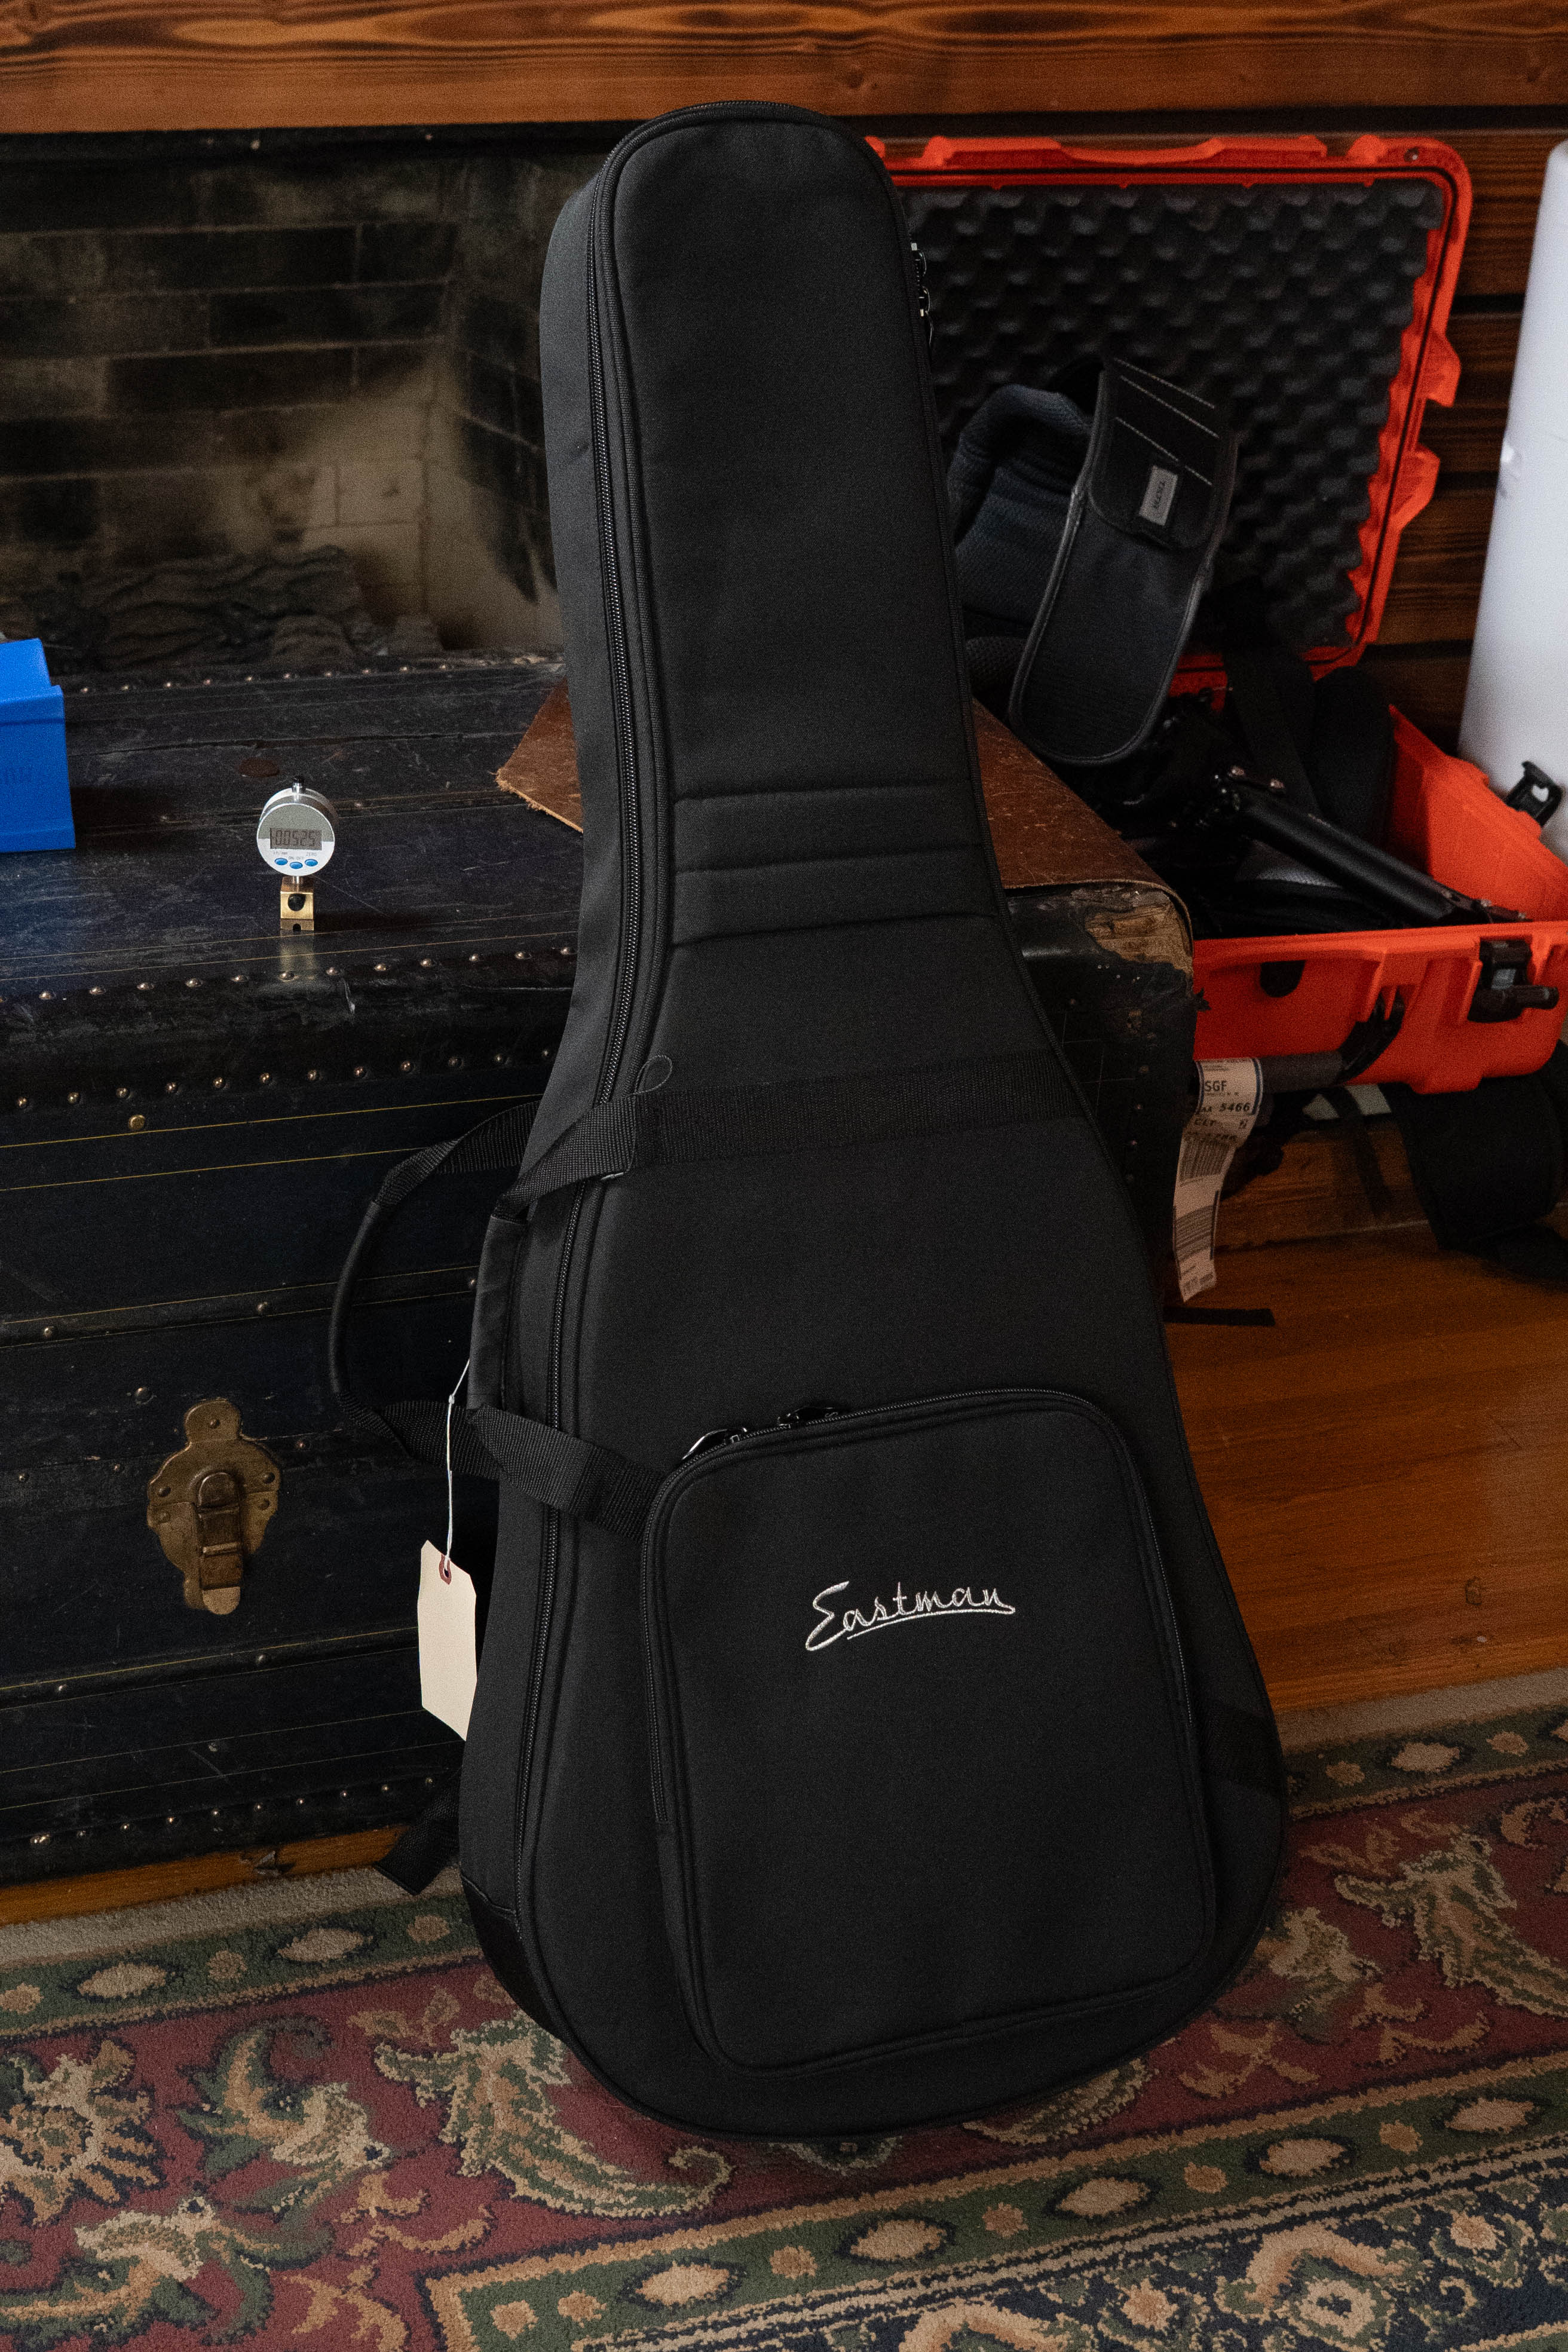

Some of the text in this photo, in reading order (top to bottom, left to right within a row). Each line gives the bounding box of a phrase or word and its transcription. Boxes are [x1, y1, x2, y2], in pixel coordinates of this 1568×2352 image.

[1204, 1080, 1227, 1092] SGF
[1218, 1102, 1251, 1113] 5466
[805, 1581, 1016, 1652] Eastman
